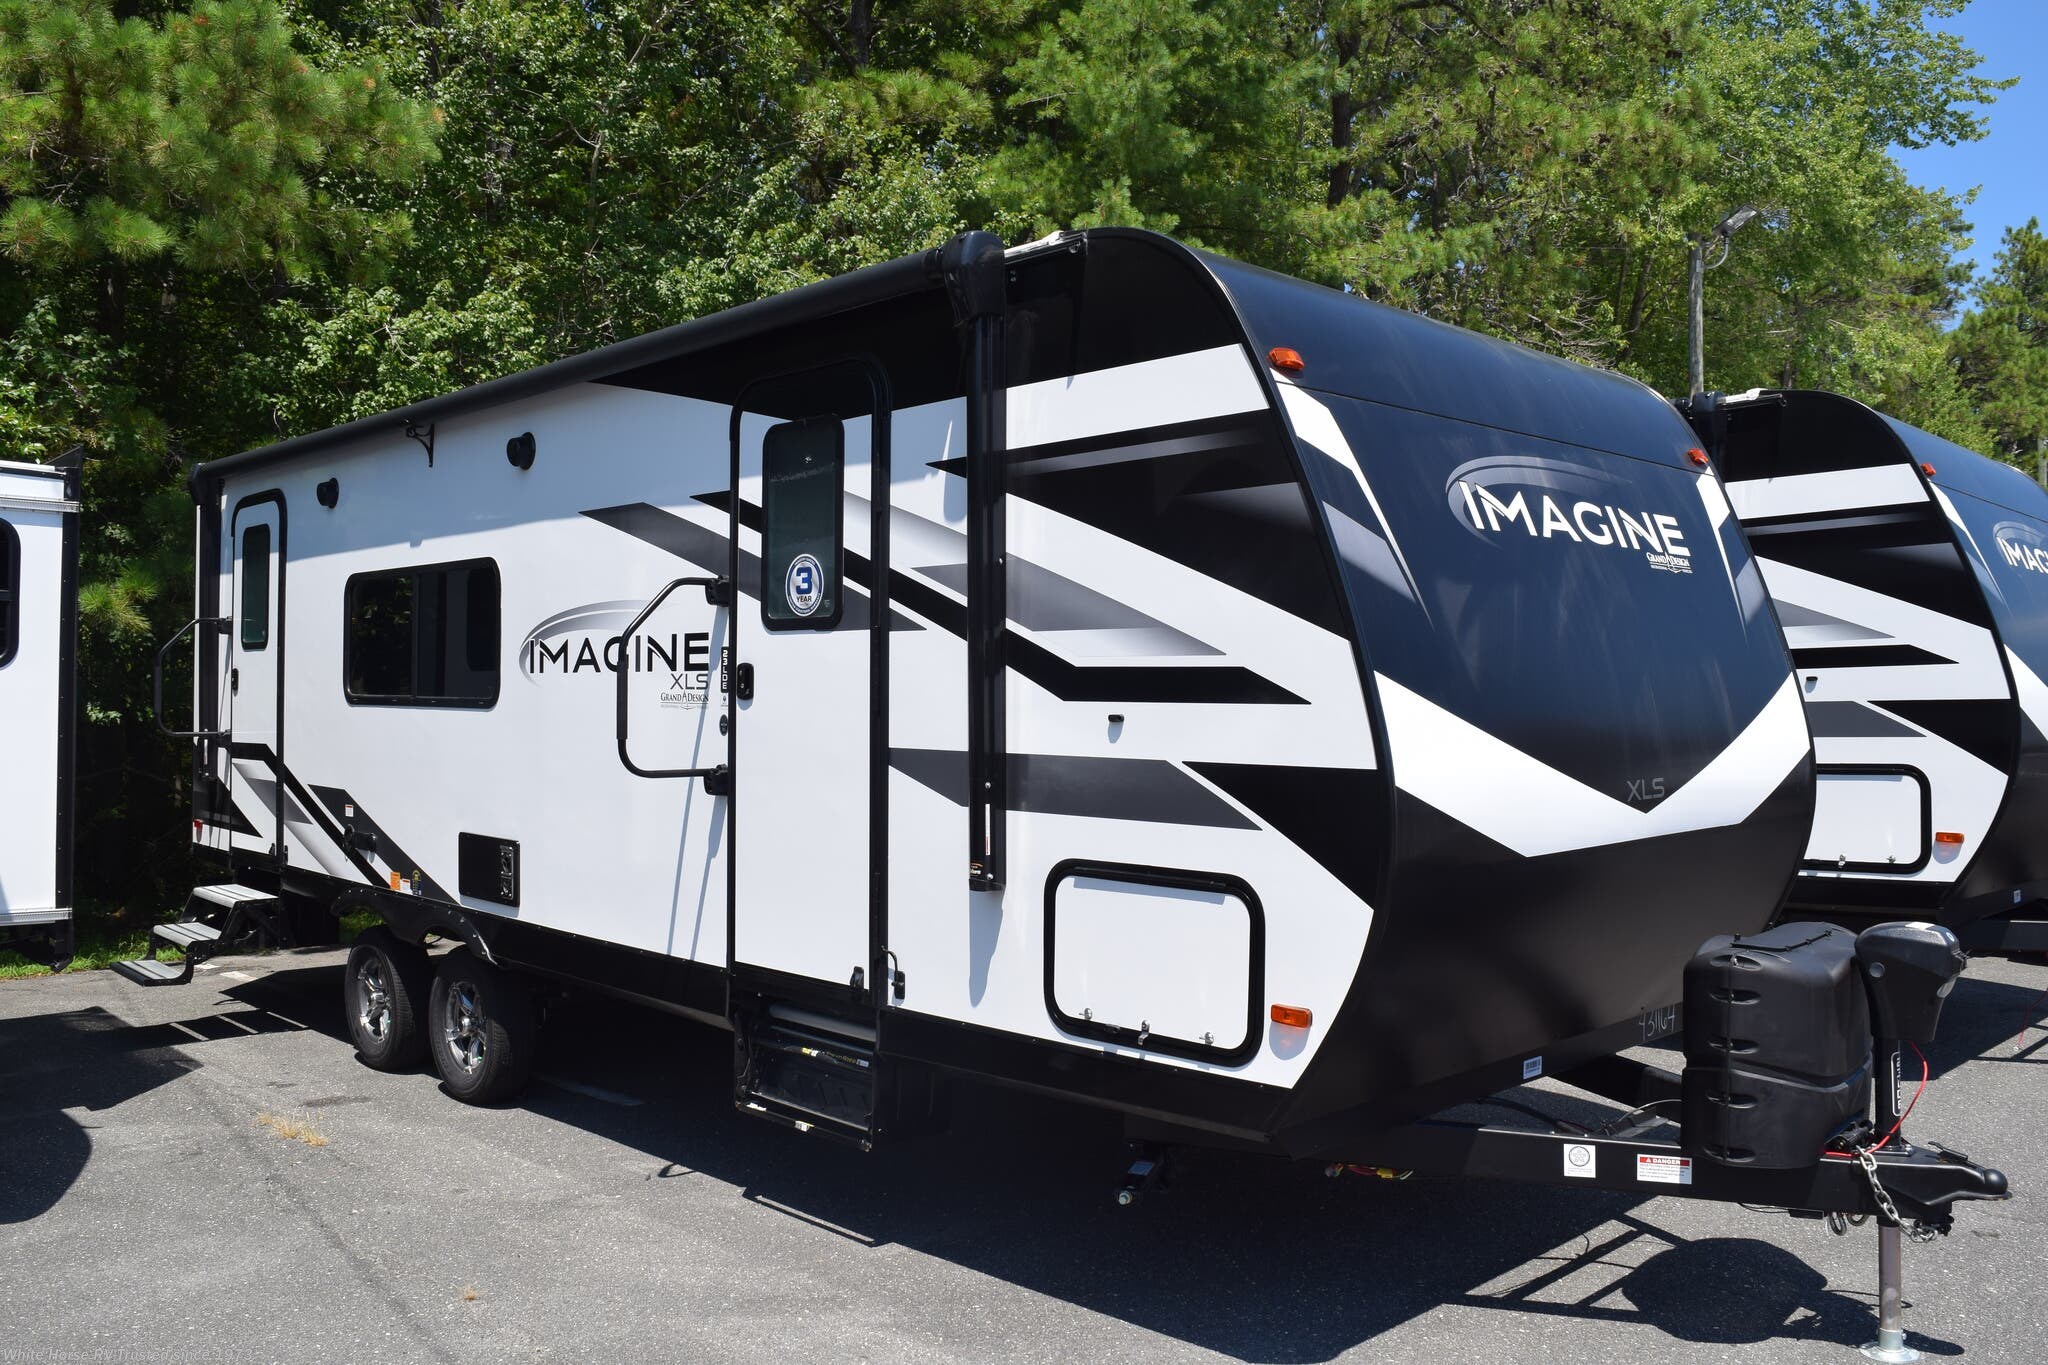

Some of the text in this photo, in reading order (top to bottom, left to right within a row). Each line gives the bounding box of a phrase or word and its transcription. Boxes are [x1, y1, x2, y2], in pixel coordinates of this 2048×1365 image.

[1458, 480, 1690, 557] IMAGINE
[796, 567, 813, 595] 3
[529, 632, 709, 674] IMAGINE
[670, 673, 708, 690] XLS
[660, 692, 682, 702] GRAND
[1626, 777, 1665, 802] XLS
[1652, 1158, 1681, 1166] DANGER
